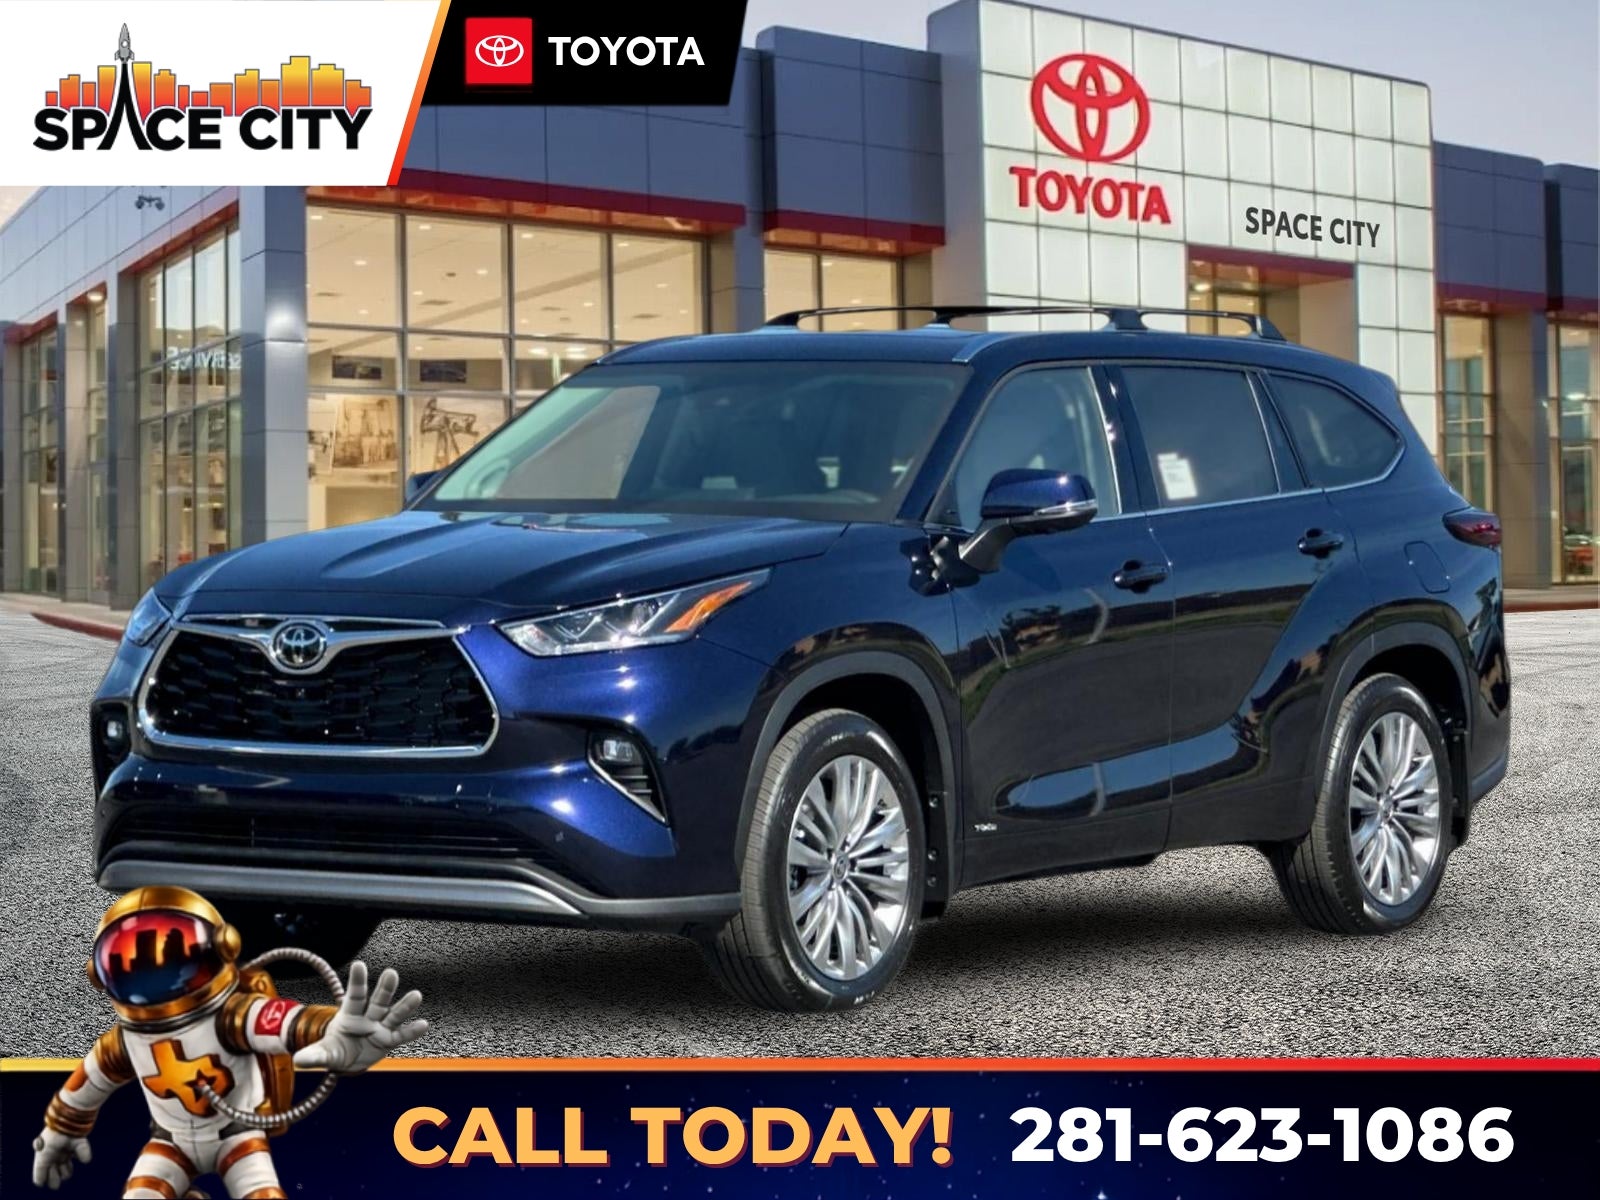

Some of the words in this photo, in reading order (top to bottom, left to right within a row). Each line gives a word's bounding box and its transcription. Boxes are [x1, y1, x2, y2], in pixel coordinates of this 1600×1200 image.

[1010, 166, 1171, 224] TOYOTA
[1245, 206, 1323, 242] SPACE
[1330, 218, 1380, 248] CITY
